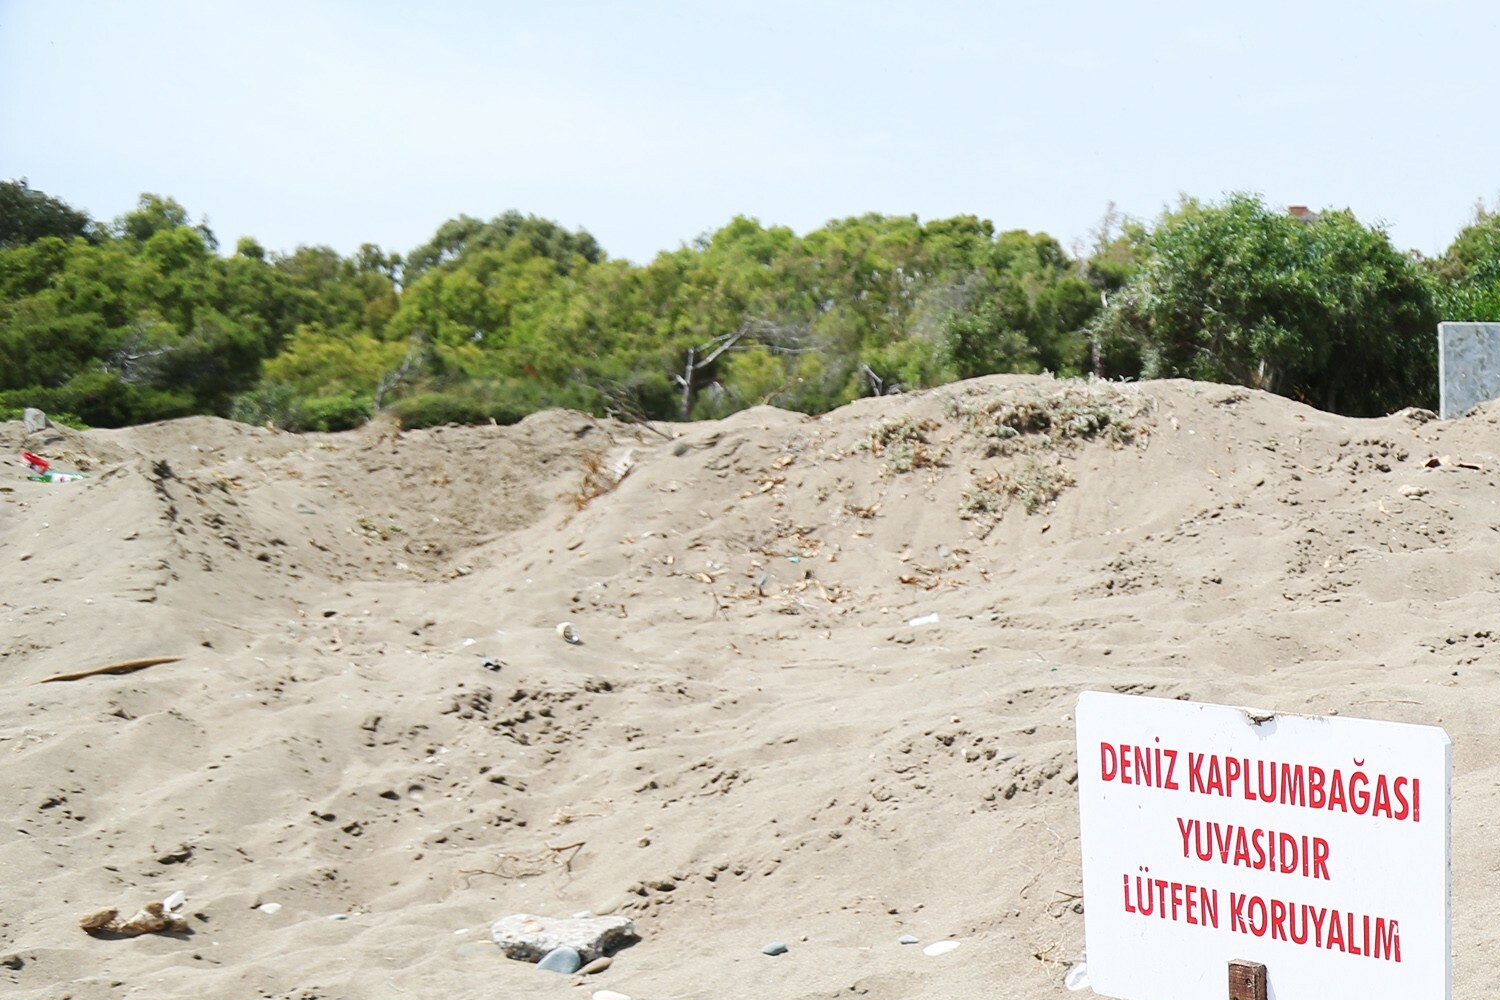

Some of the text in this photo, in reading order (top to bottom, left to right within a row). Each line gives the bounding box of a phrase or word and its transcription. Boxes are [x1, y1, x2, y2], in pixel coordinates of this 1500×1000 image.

[1101, 737, 1421, 822] DENİZ KAPLUMBAĞASI
[1177, 818, 1331, 881] YUVASIDIR
[1124, 866, 1402, 963] LÜTFEN KORUYALIM
